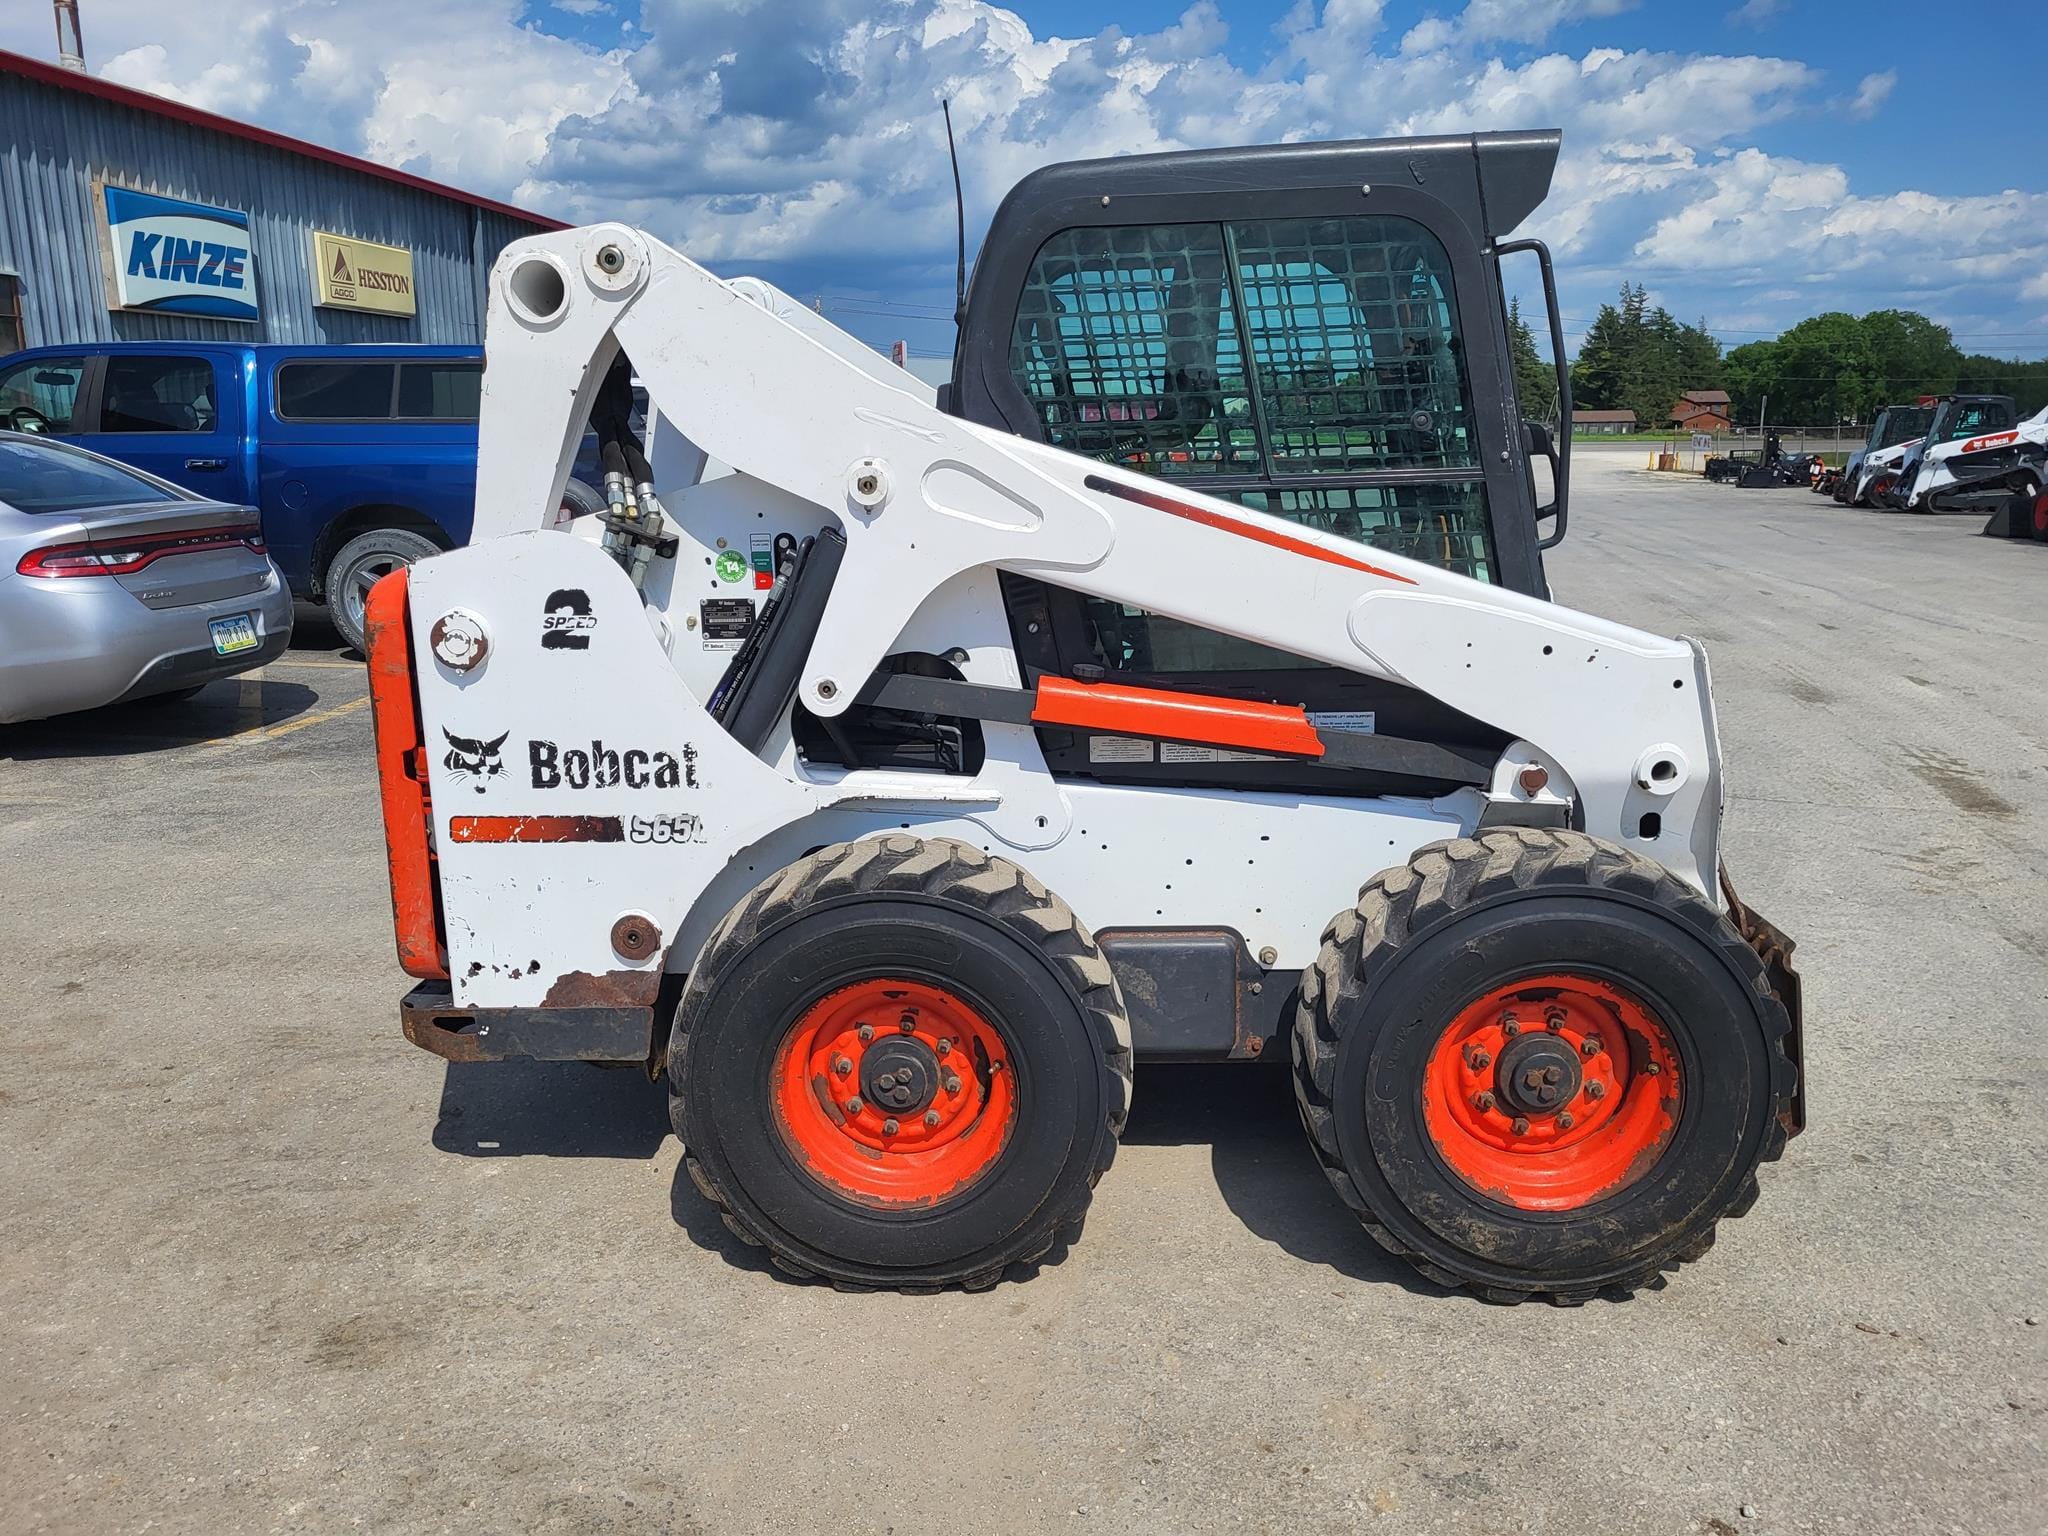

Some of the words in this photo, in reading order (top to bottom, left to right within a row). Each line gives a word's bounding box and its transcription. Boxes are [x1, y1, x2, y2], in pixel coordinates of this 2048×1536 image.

[127, 230, 248, 290] KINZE
[357, 267, 410, 295] HESSTON
[333, 287, 355, 299] AGCO
[1984, 437, 2009, 448] Bobcat
[724, 560, 740, 573] T4
[541, 588, 592, 650] 2
[543, 616, 598, 629] SPEED
[528, 739, 700, 790] Bobcat
